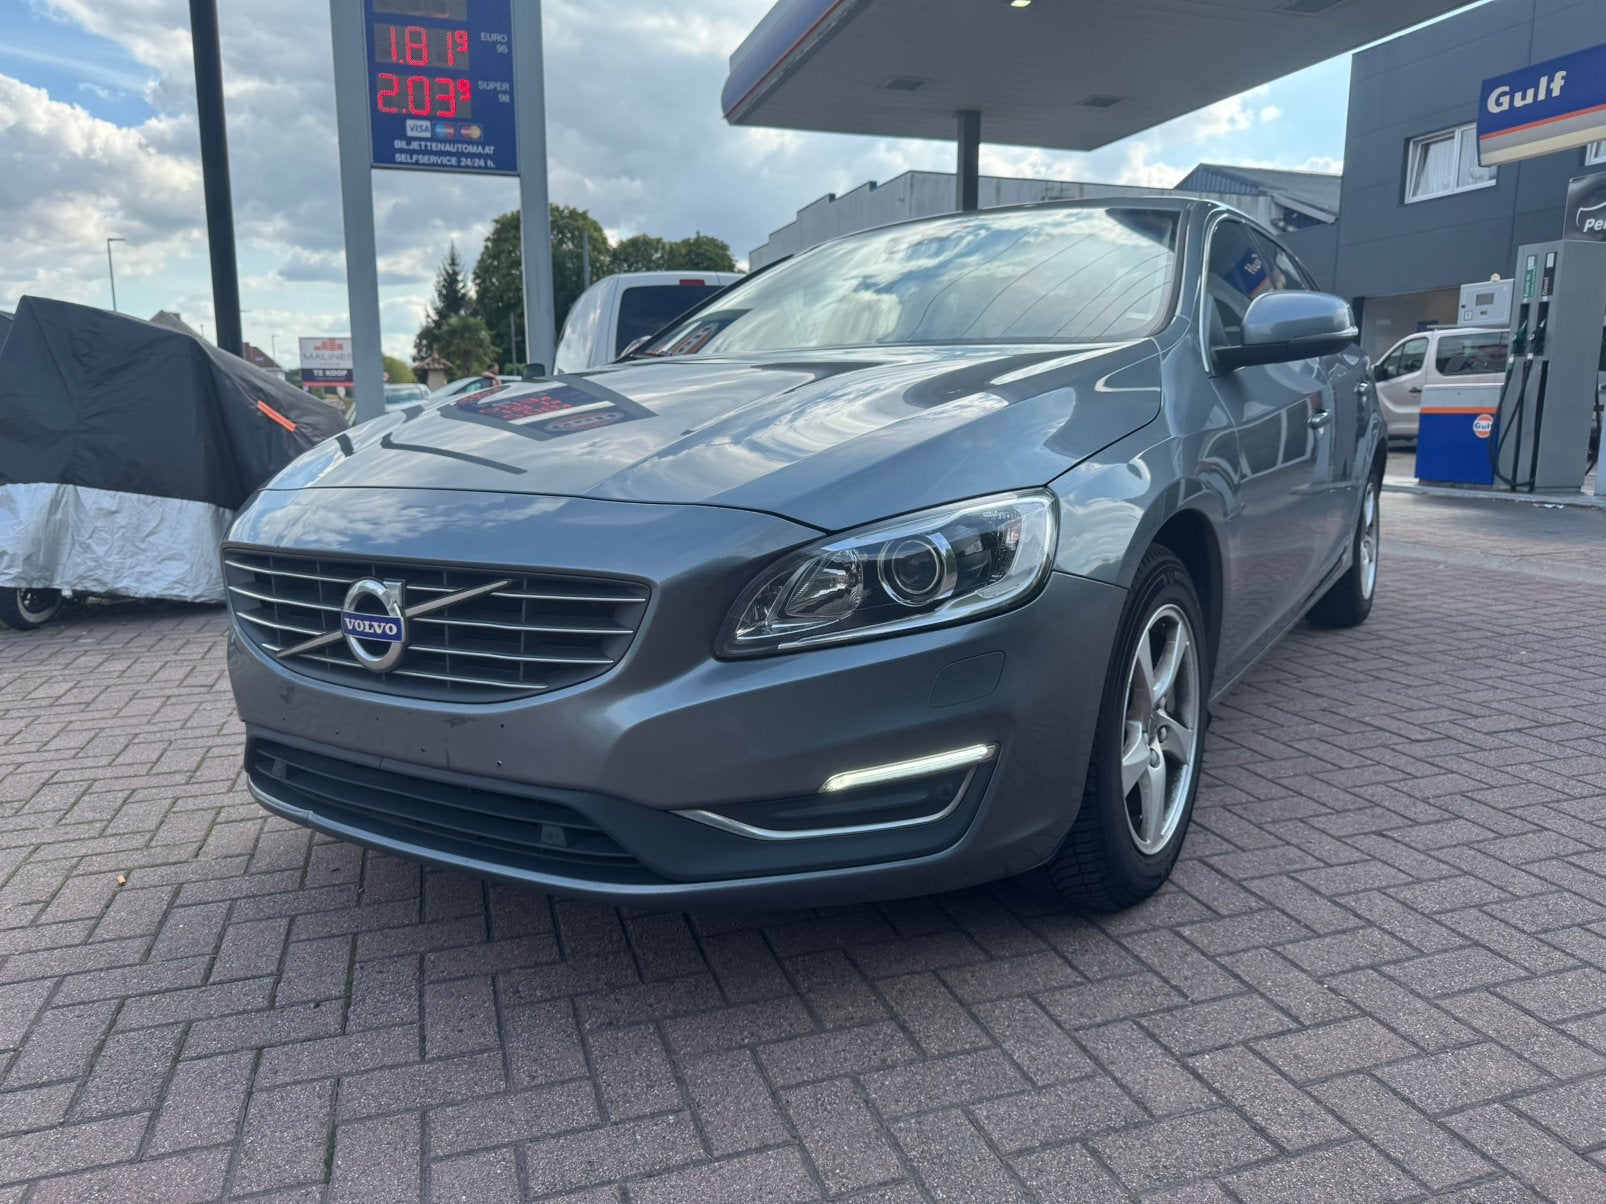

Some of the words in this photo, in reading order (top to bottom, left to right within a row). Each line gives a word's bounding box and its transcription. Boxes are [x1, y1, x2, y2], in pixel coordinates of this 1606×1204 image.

[480, 32, 508, 43] EURO
[496, 44, 508, 54] 95
[478, 81, 510, 92] SUPER
[1486, 70, 1567, 114] Gulf
[409, 123, 430, 133] VISA
[394, 140, 495, 154] BILJETTENAUTOMAAT
[394, 153, 458, 167] SELFSERVICE
[313, 369, 324, 377] TE
[325, 369, 348, 377] KOOP
[1474, 422, 1492, 430] Gul
[344, 617, 398, 636] VOLVO
